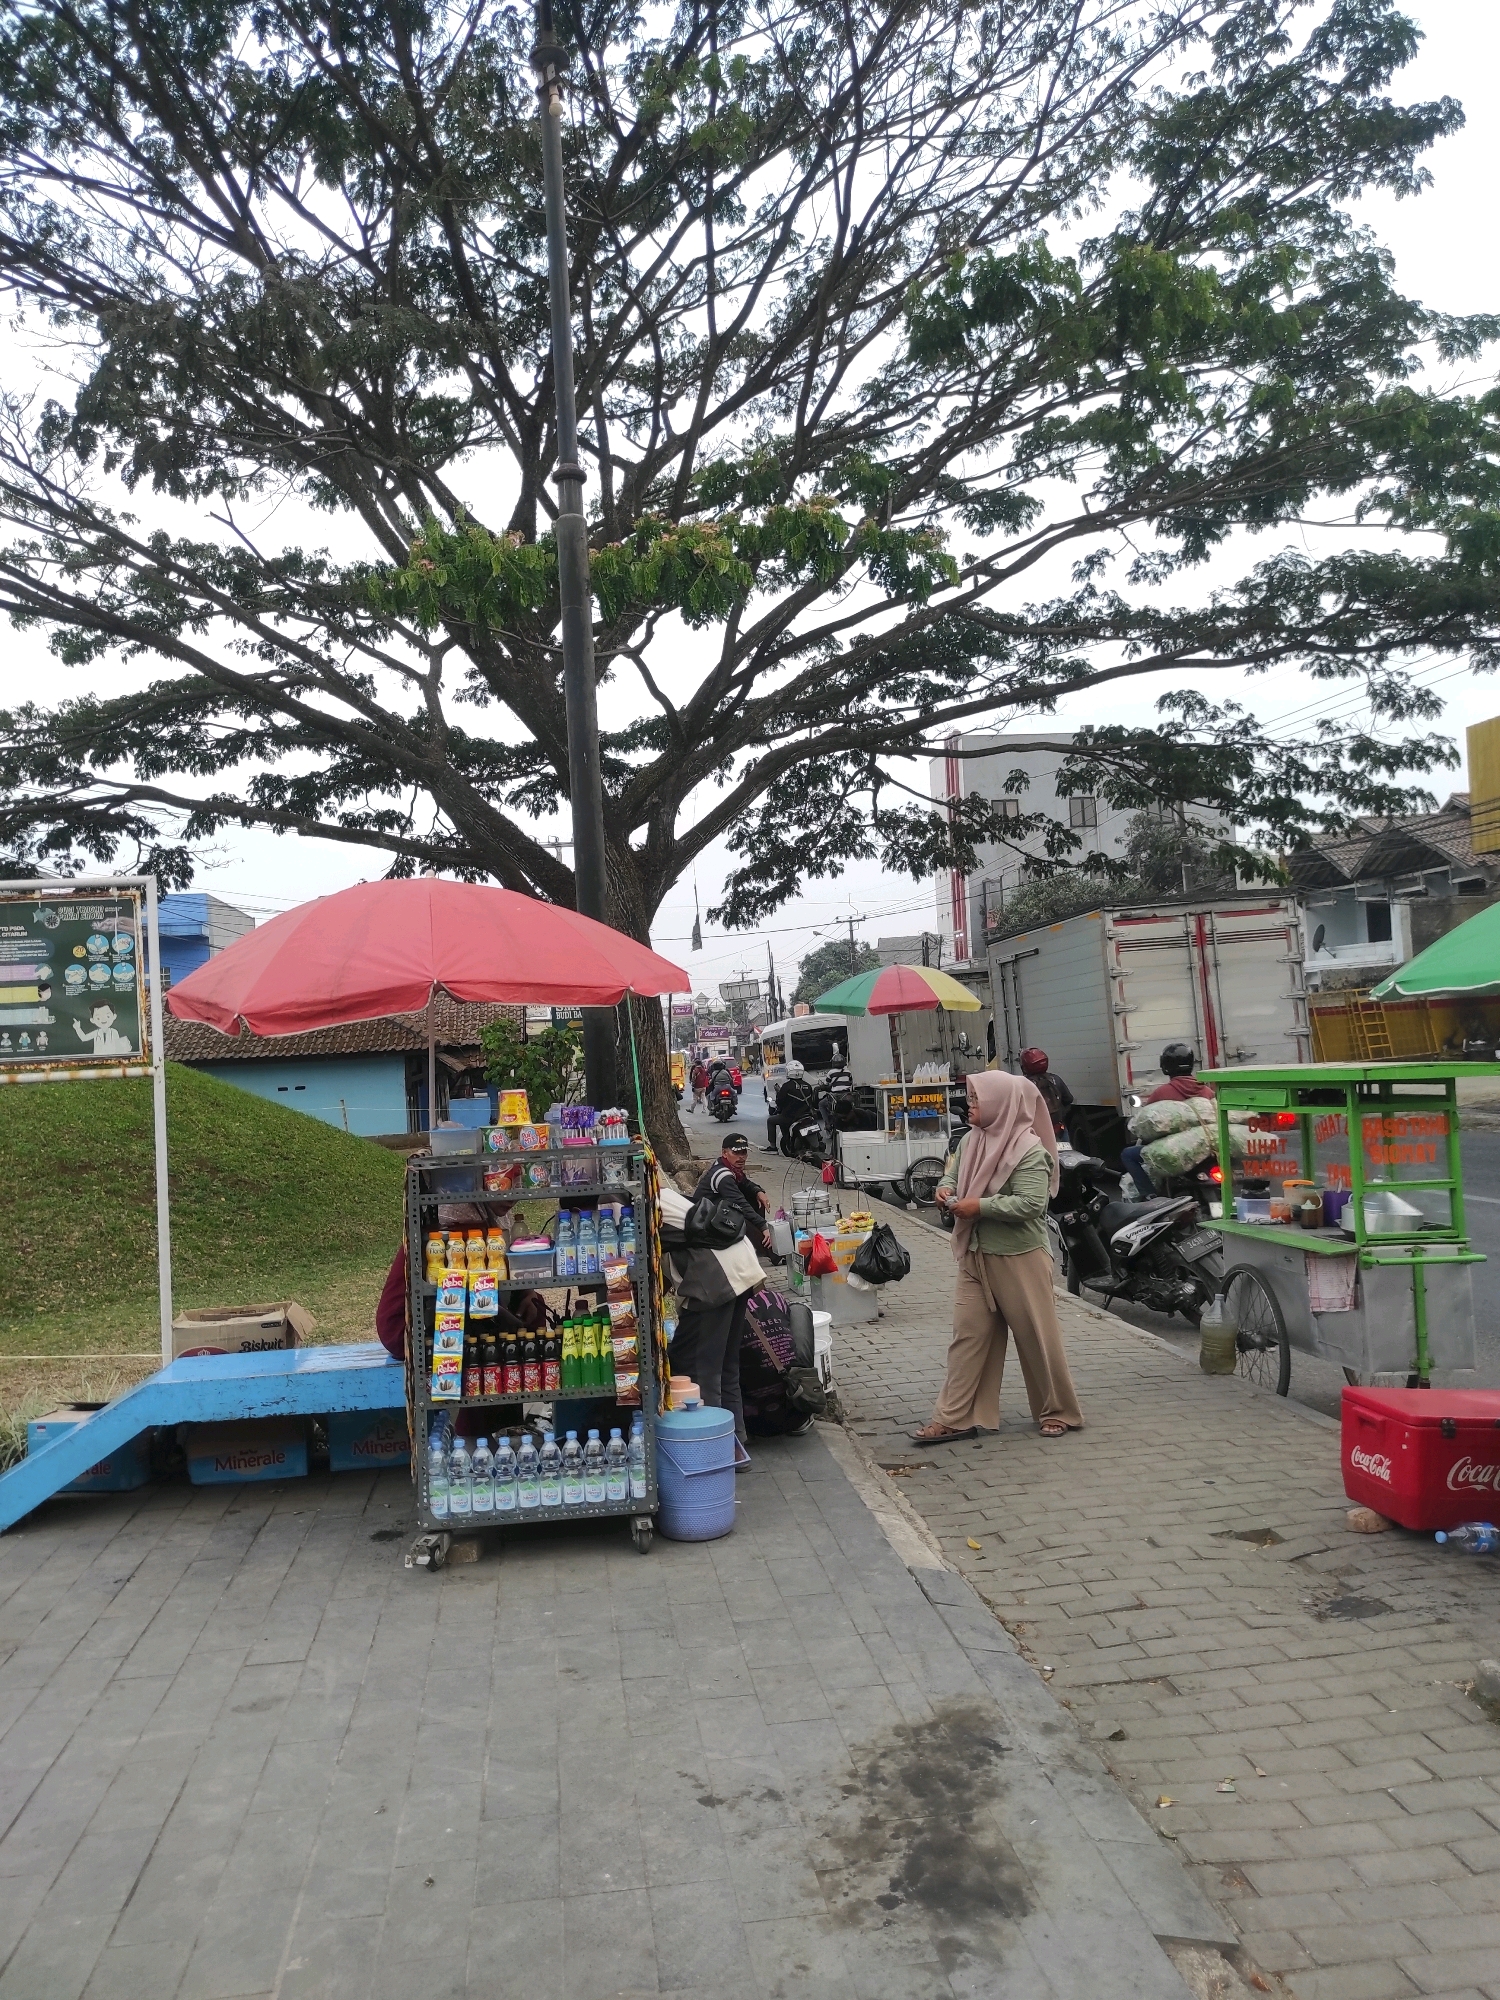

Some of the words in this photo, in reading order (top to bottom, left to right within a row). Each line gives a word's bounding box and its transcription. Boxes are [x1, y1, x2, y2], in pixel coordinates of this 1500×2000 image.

[556, 1011, 572, 1019] BUDI
[891, 1095, 904, 1104] ES
[908, 1093, 943, 1103] JERUK
[1370, 1143, 1436, 1165] SIOMAY
[442, 1278, 463, 1289] Rebo
[474, 1279, 495, 1292] Rebo
[439, 1320, 460, 1331] Rebo
[239, 1338, 284, 1353] Biskuit
[437, 1363, 458, 1376] Rebo
[376, 1425, 395, 1441] Le
[214, 1449, 285, 1472] Minerale
